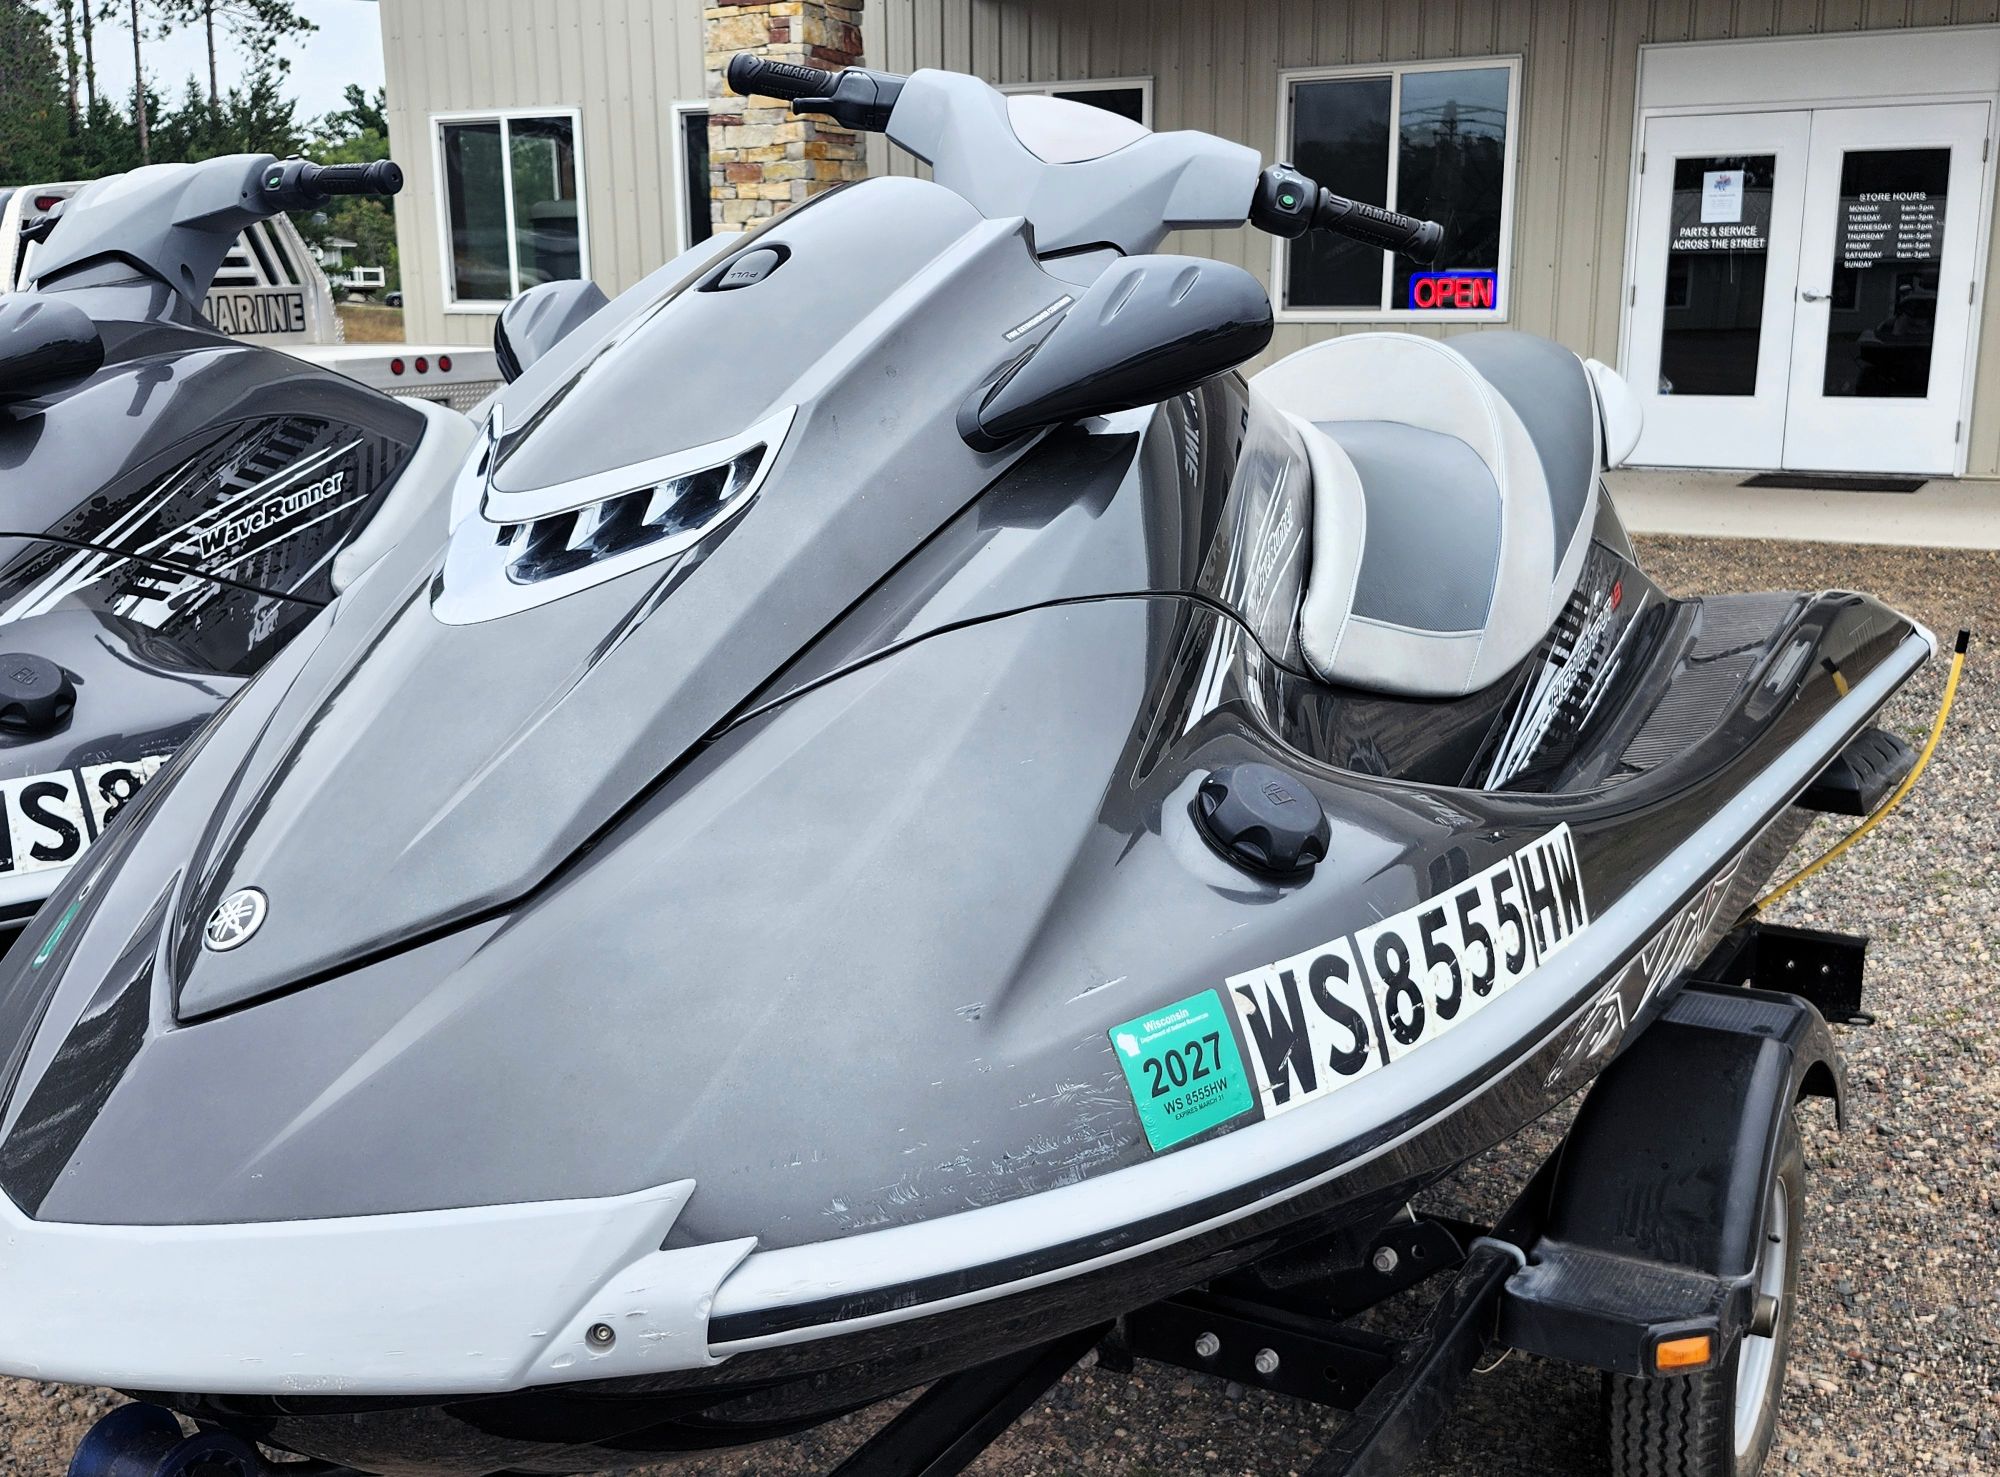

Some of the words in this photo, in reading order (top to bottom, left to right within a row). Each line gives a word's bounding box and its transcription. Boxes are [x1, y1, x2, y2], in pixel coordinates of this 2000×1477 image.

[768, 62, 815, 81] YAMAHA
[1859, 192, 1891, 202] STORE
[1892, 191, 1926, 201] HOURS
[1358, 203, 1409, 229] YAMAHA
[1680, 226, 1709, 237] PARTS
[1710, 226, 1718, 237] &
[1719, 225, 1758, 237] SERVICE
[1847, 223, 1892, 231] WEDNESDAY
[1847, 232, 1884, 240] THURSDAY
[1672, 239, 1710, 250] ACROSS
[1711, 239, 1729, 249] THE
[1730, 238, 1765, 249] STREET
[1845, 242, 1871, 250] FRIDAY
[1844, 251, 1883, 259] SATURDAY
[1844, 260, 1873, 269] SUNDAY
[730, 271, 759, 279] PULL
[1413, 277, 1493, 308] OPEN
[199, 471, 345, 560] WaveRunner
[0, 781, 80, 872] S
[1235, 953, 1369, 1106] WS
[1373, 868, 1526, 1045] 8555
[1520, 832, 1584, 955] HW
[1142, 1009, 1189, 1033] Wisconsin
[1142, 1031, 1222, 1099] 2027
[1163, 1098, 1184, 1115] WS
[1185, 1077, 1229, 1106] 8555HW
[1175, 1105, 1199, 1121] EXPIRES
[1199, 1098, 1218, 1112] MARCH
[1217, 1094, 1225, 1104] 31
